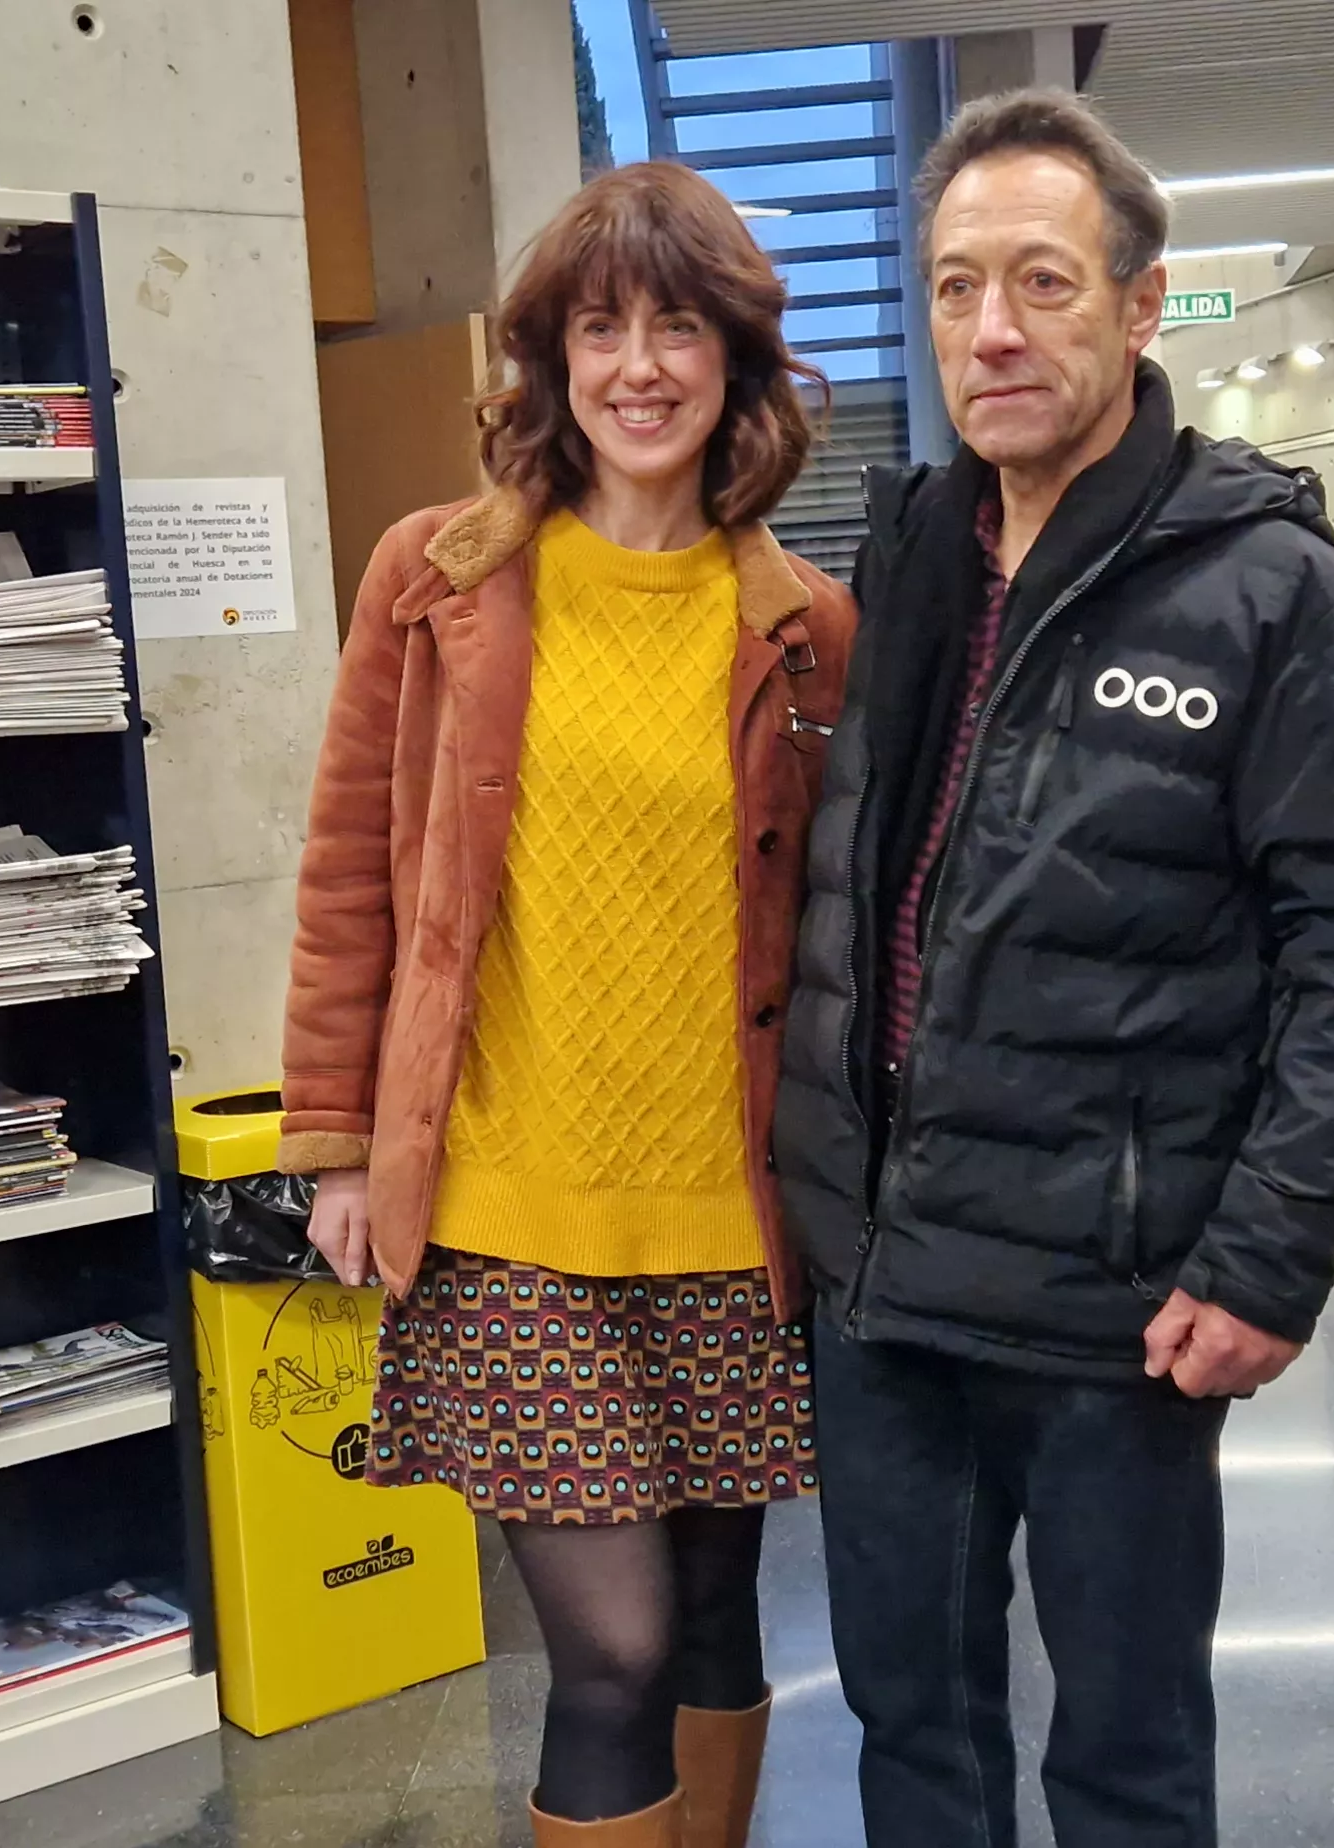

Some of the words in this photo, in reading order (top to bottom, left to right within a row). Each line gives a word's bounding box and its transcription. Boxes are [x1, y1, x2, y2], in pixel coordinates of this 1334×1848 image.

[192, 503, 203, 512] de
[263, 504, 268, 512] y
[158, 518, 168, 526] de
[173, 518, 181, 526] la
[186, 517, 241, 526] Hemeroteca
[246, 516, 256, 524] de
[260, 516, 268, 524] la
[156, 532, 188, 541] Ramón
[201, 531, 233, 540] Sender
[252, 530, 269, 538] sido
[184, 548, 199, 556] por
[207, 545, 215, 553] la
[222, 544, 271, 554] Diputación
[168, 560, 179, 569] de
[193, 560, 225, 568] Huesca
[176, 574, 202, 582] anual
[207, 573, 218, 581] de
[224, 573, 273, 581] Dotaciones
[180, 588, 201, 597] 2024
[327, 1549, 411, 1585] ecoembes
